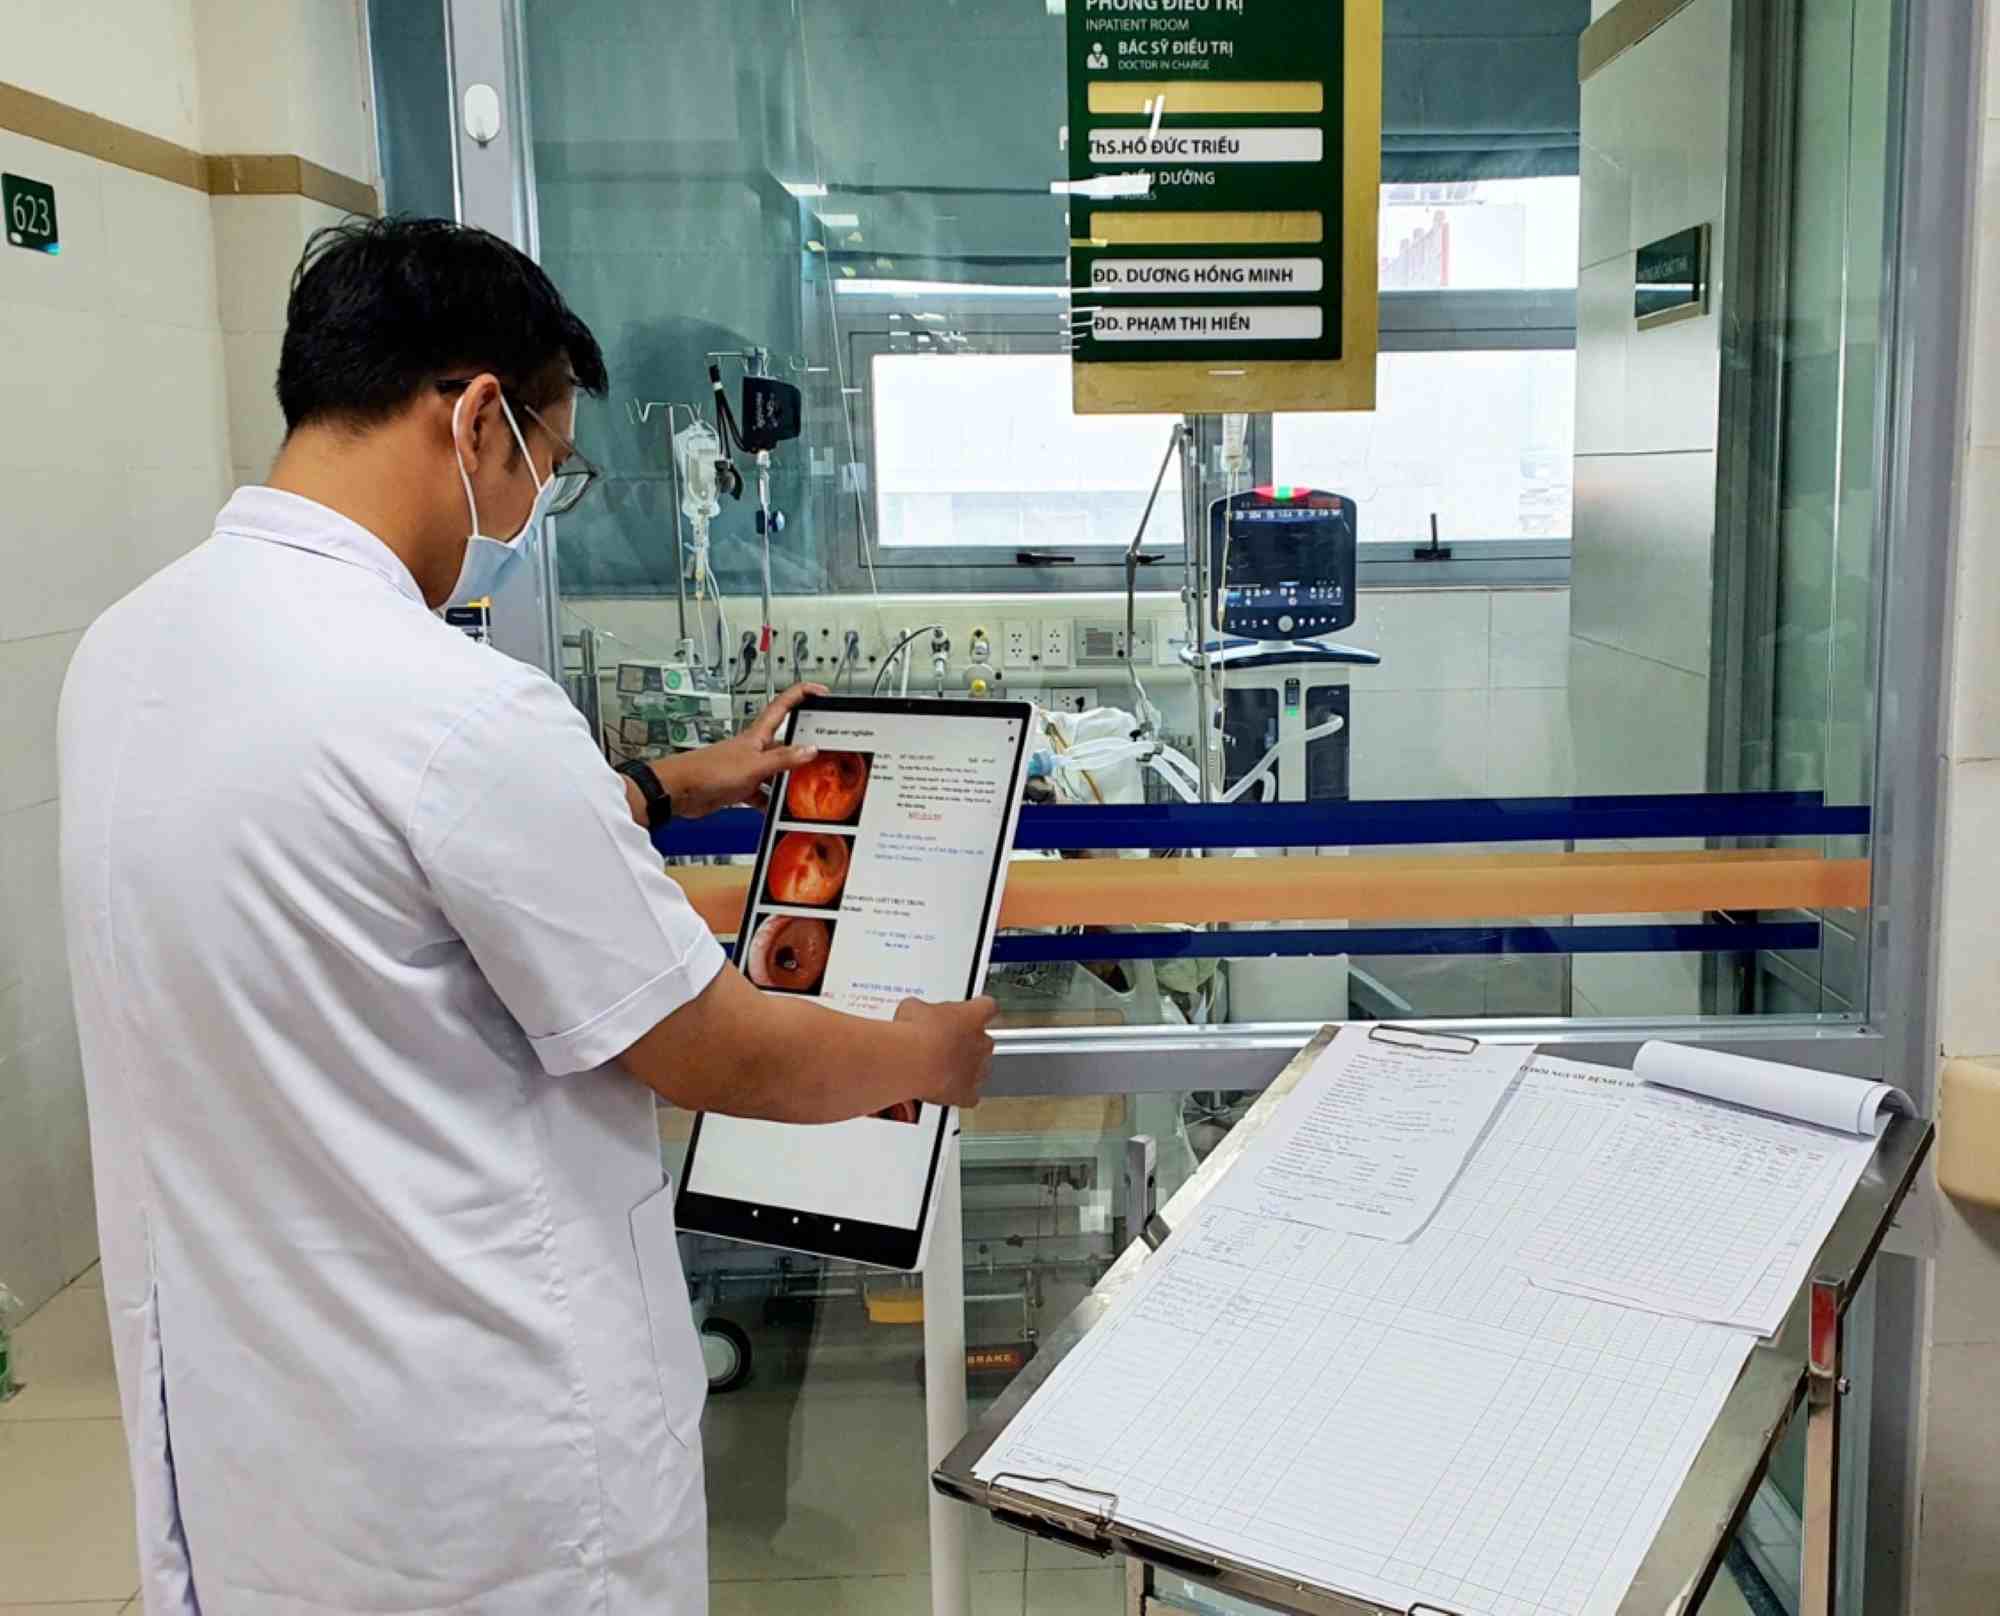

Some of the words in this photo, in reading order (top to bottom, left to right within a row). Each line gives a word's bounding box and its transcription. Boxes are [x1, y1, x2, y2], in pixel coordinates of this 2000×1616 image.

[1086, 18, 1147, 31] INPATIENT
[1150, 18, 1190, 31] ROOM
[1118, 38, 1149, 54] BÁC
[1151, 38, 1169, 54] SỸ
[1210, 41, 1233, 58] TRỊ
[1151, 136, 1189, 155] ĐỨC
[13, 193, 50, 236] 623
[1093, 268, 1122, 283] ĐD.
[1126, 267, 1190, 283] DƯƠNG
[1248, 268, 1294, 283] MINH
[1094, 316, 1122, 331] ĐD.
[1127, 316, 1176, 335] PHẠM
[1180, 316, 1207, 335] THỊ
